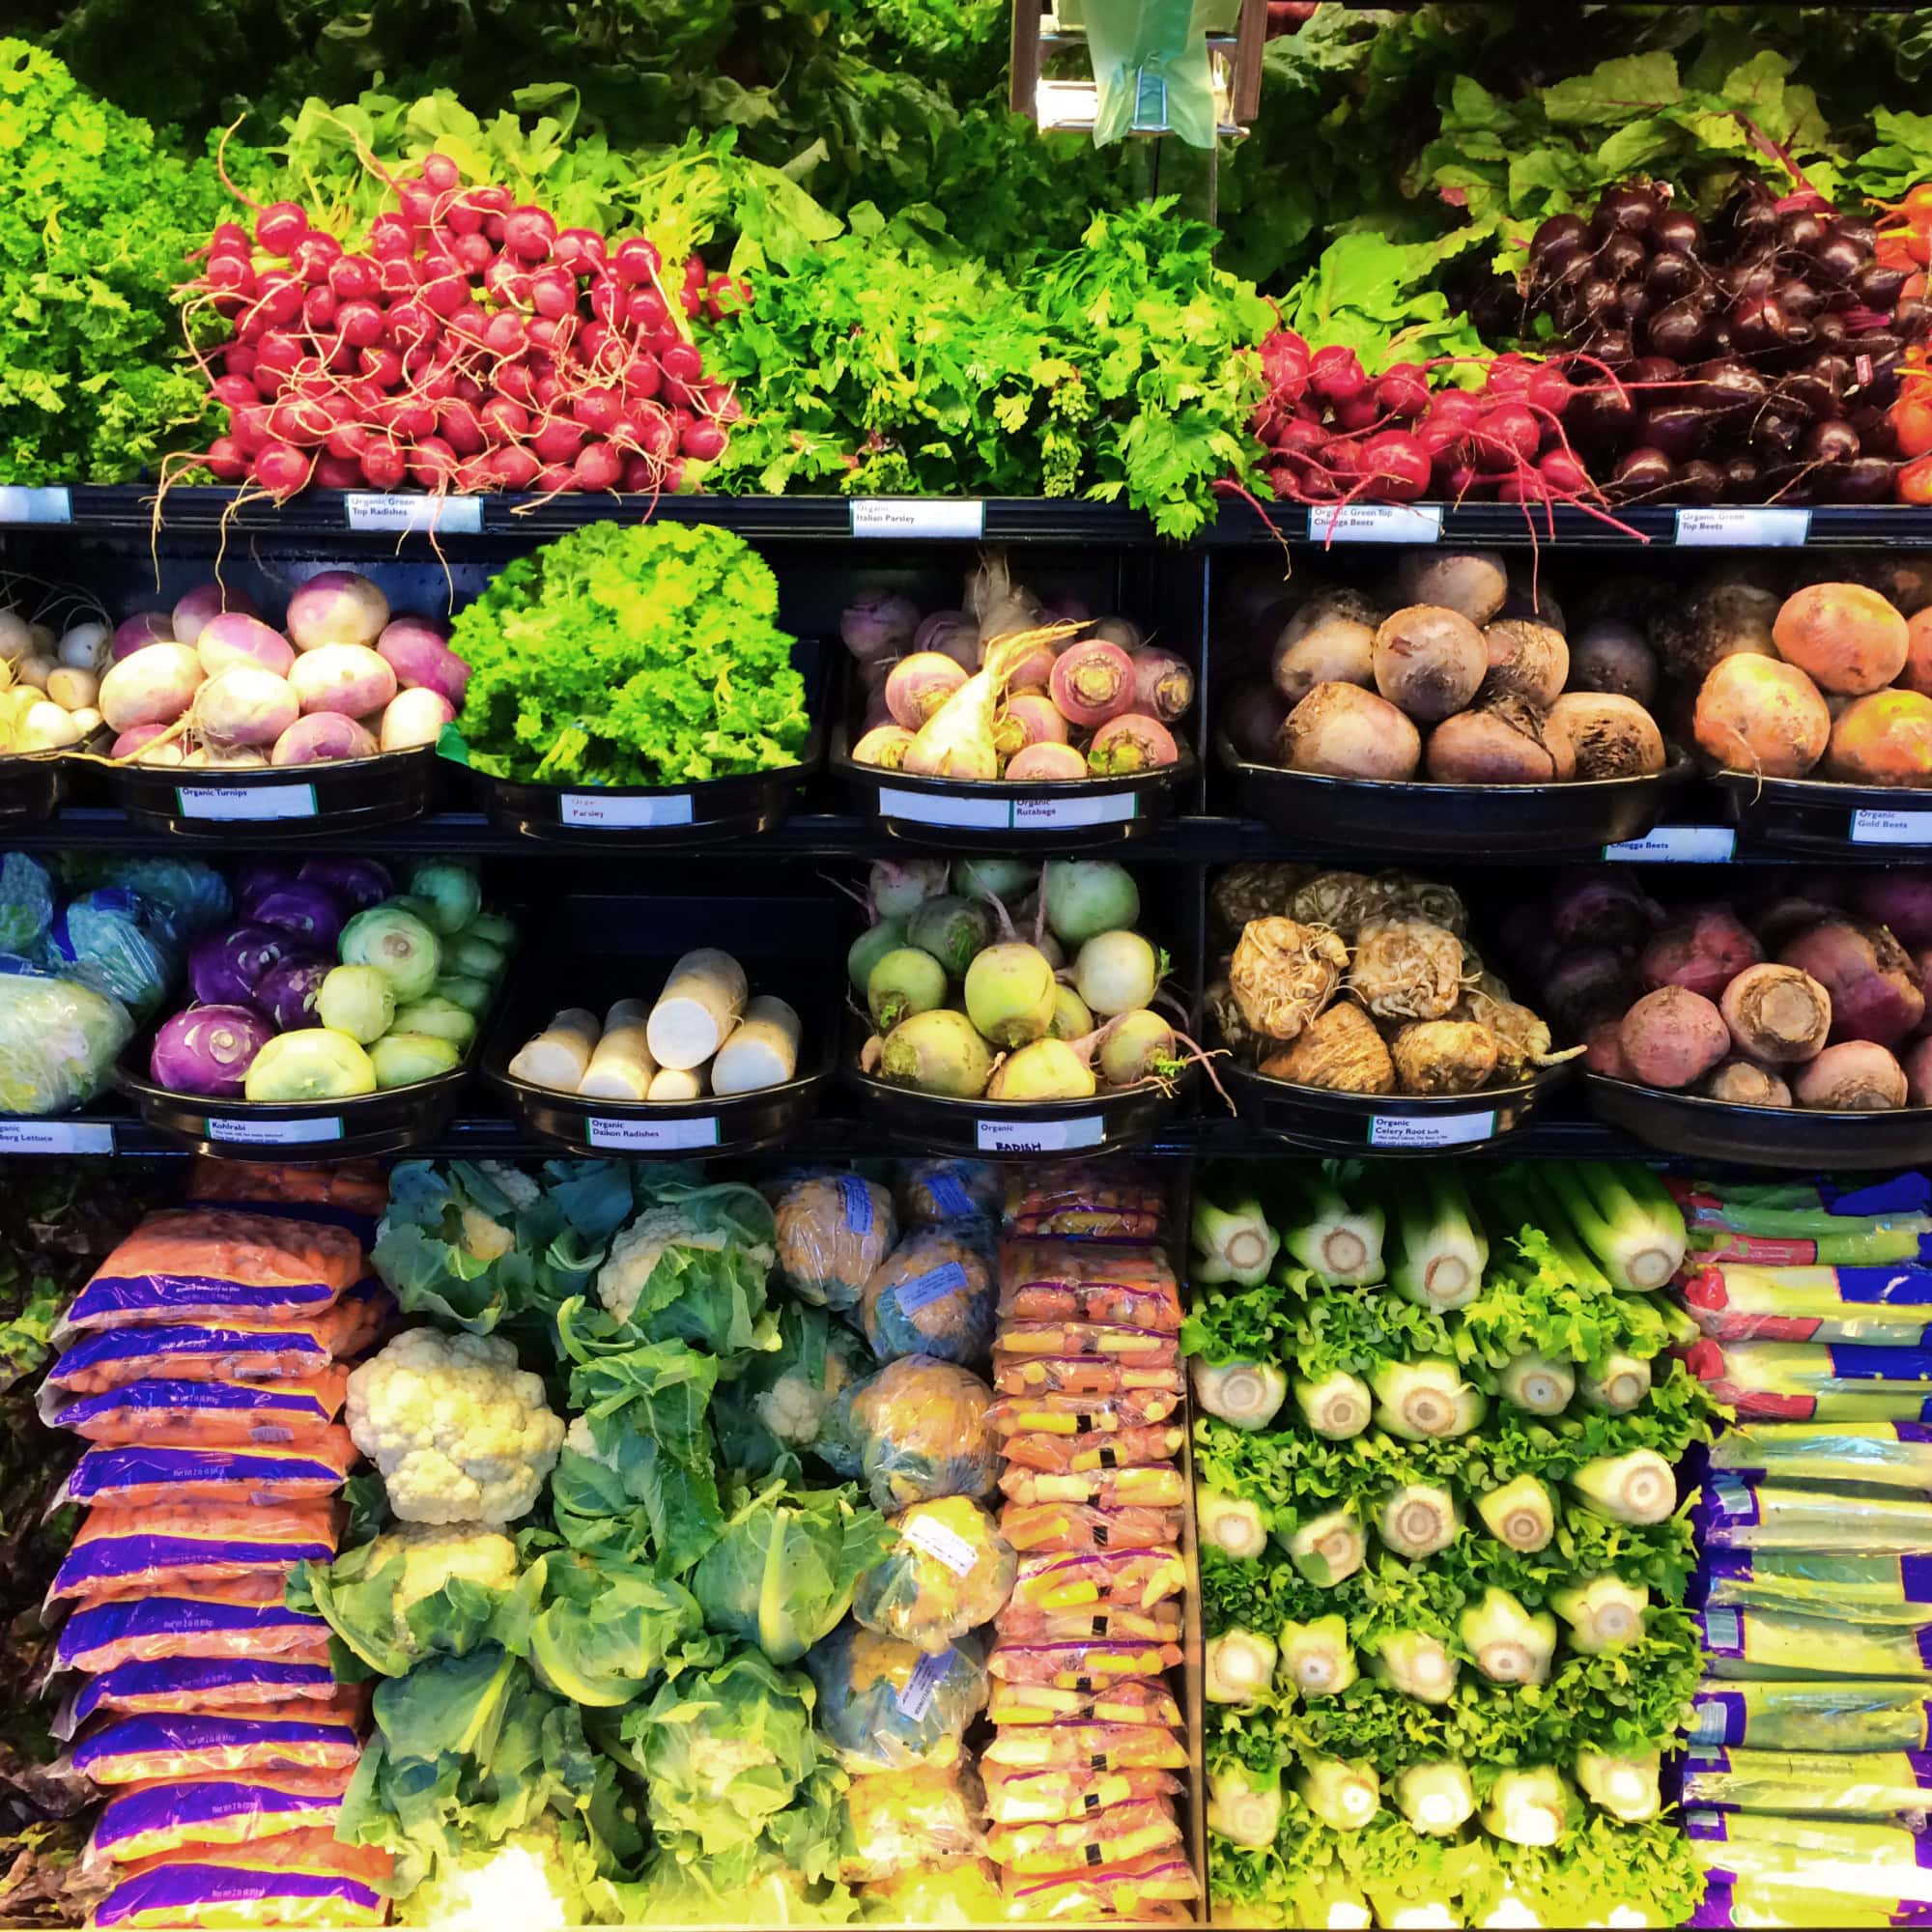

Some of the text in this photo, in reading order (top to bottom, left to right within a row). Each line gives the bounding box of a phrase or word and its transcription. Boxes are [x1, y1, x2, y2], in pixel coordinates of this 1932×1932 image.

[388, 497, 415, 506] Green
[352, 507, 368, 517] Top
[1315, 508, 1393, 519] Orgic Green Top
[857, 514, 915, 525] Italian Parsley
[1682, 522, 1697, 531] Top
[183, 787, 247, 798] Organic Turnips
[573, 810, 604, 819] Parsley
[1017, 808, 1056, 817] Rutabaga
[1860, 810, 1894, 819] Organic
[1858, 819, 1908, 829] Gold Beets
[213, 1122, 245, 1130] Kohlrabi
[592, 1120, 625, 1128] Organic
[981, 1123, 1012, 1132] Organic
[1376, 1119, 1409, 1127] Organic
[593, 1128, 621, 1137] Daikon
[1376, 1126, 1404, 1136] Celery
[996, 1141, 1041, 1151] RADISH
